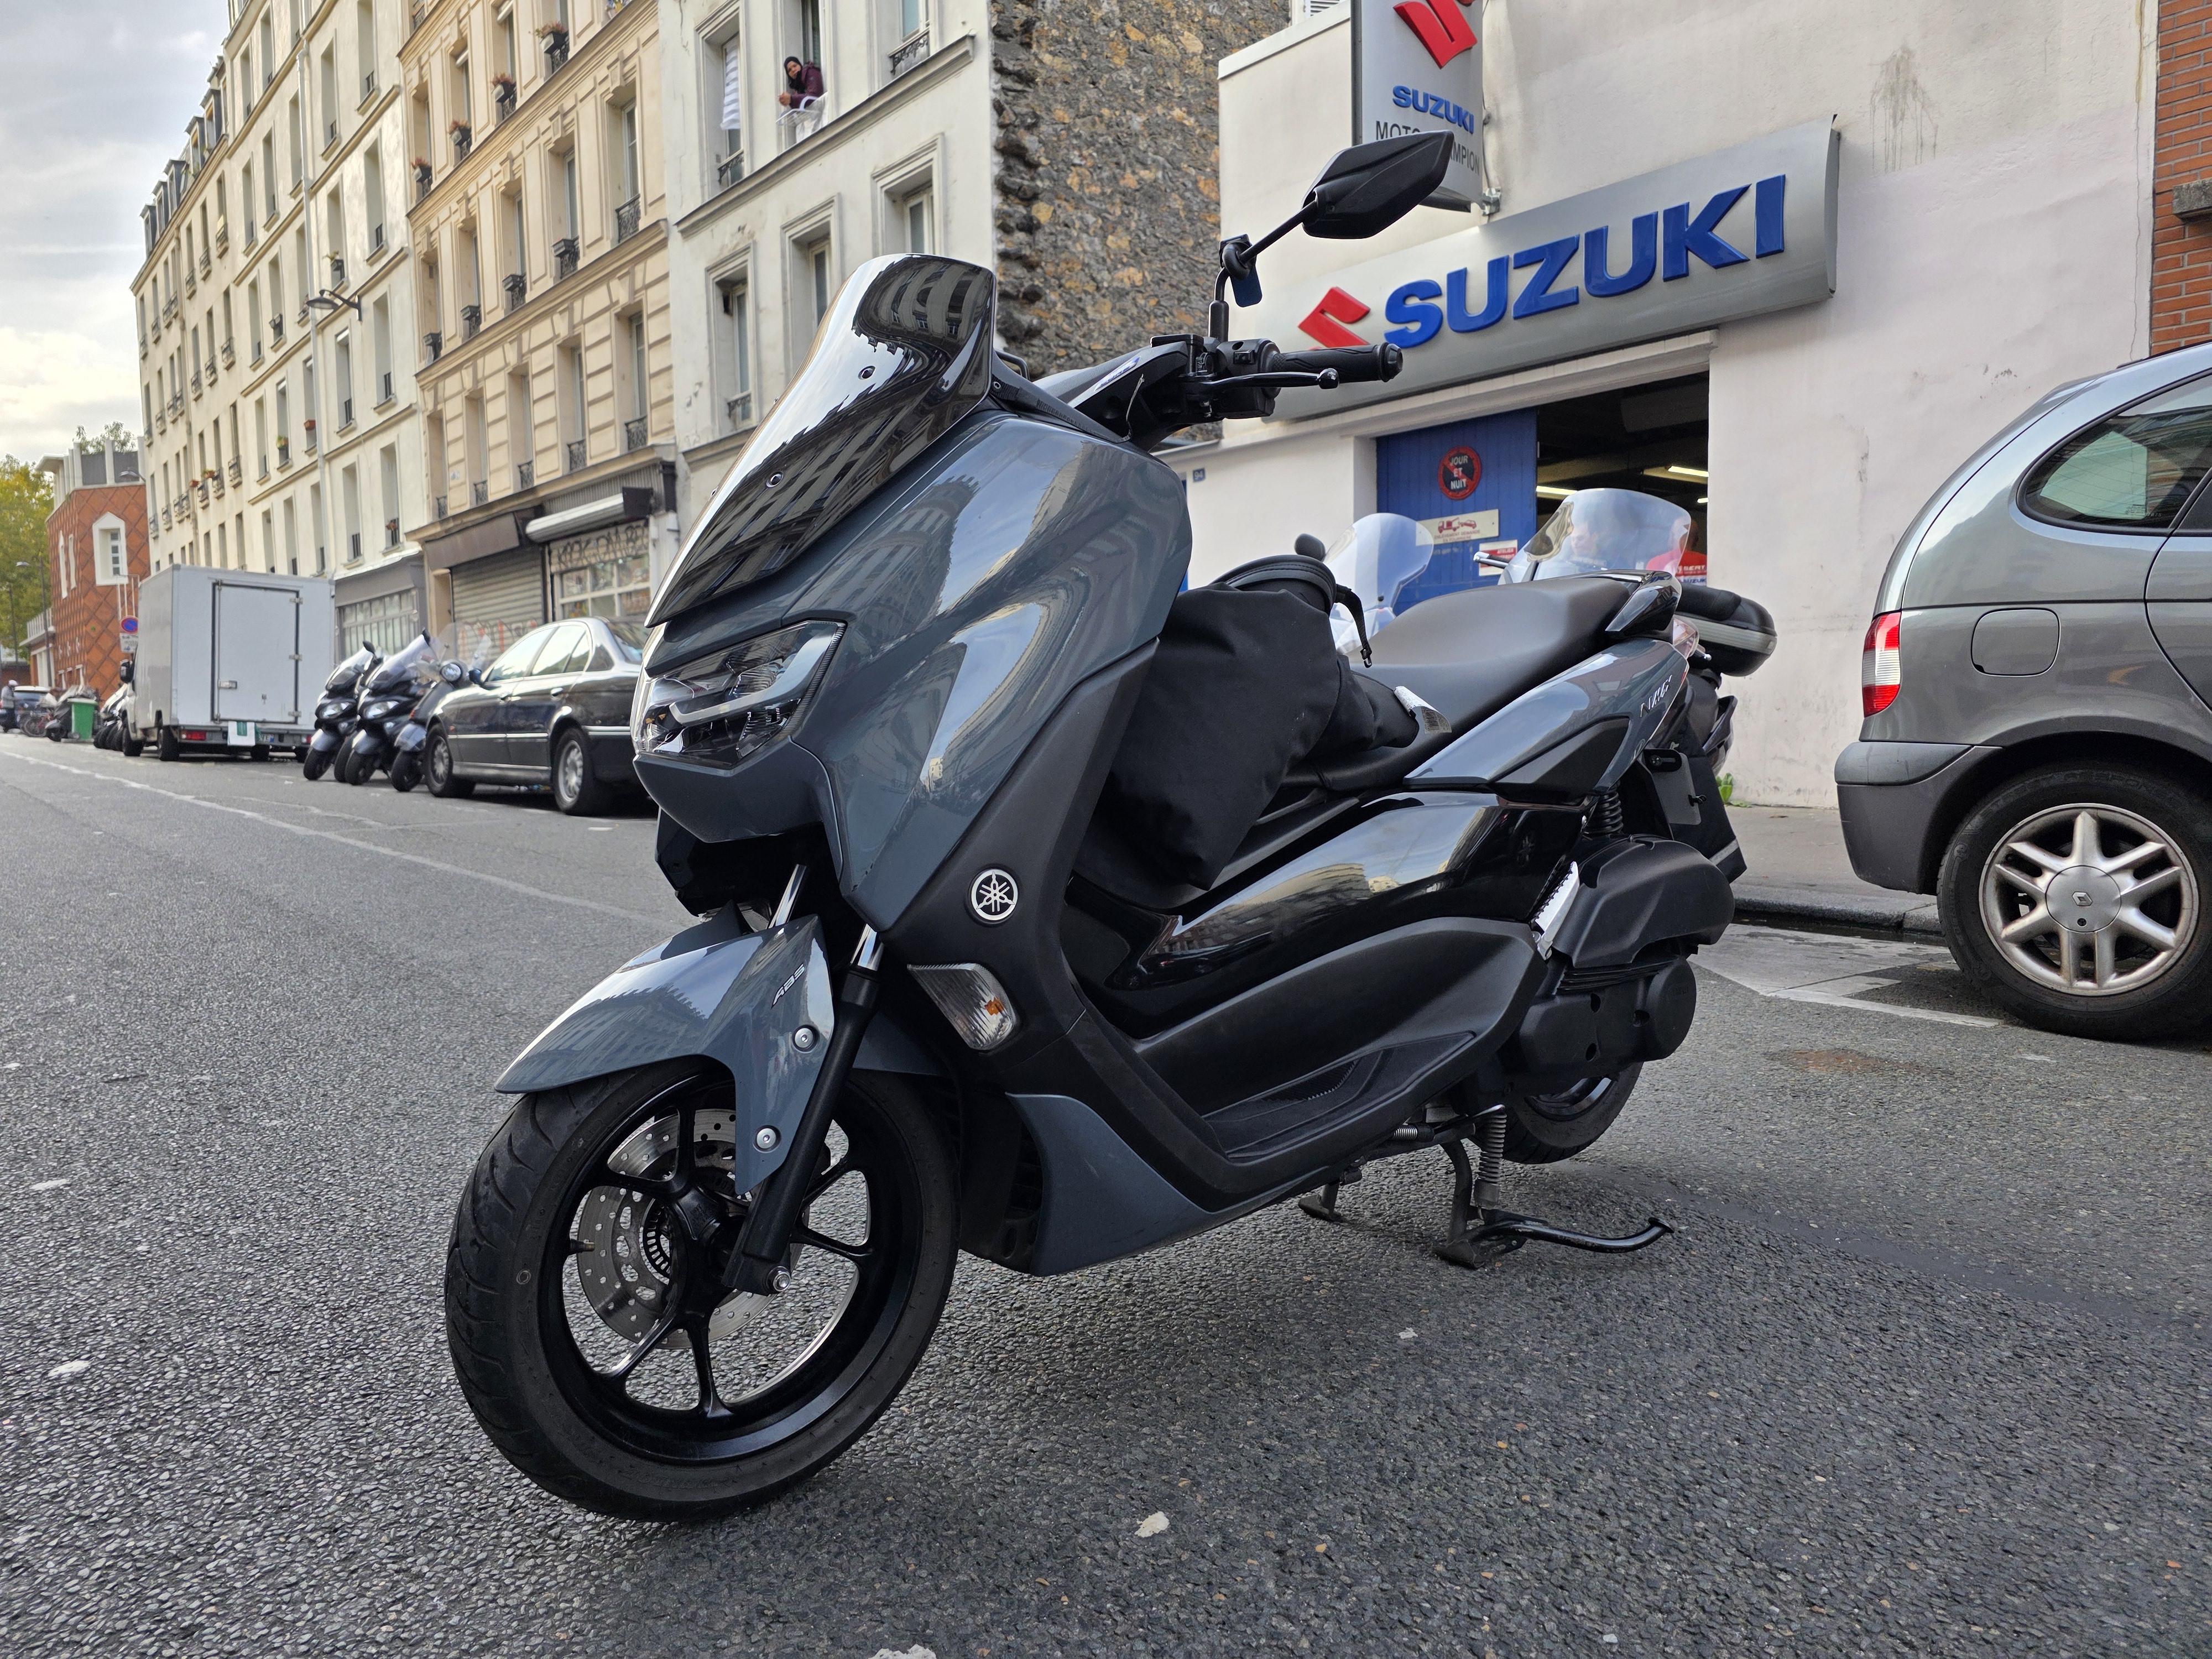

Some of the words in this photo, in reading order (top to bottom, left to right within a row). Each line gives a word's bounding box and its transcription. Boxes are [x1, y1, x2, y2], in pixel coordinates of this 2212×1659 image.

[1392, 85, 1474, 135] SUZUKI
[1450, 142, 1480, 176] MPION
[1384, 174, 1786, 348] SUZUKI
[1449, 455, 1468, 466] JOUR
[1453, 467, 1463, 477] ET
[1194, 471, 1203, 480] 94
[1451, 478, 1467, 490] NUIT
[771, 963, 805, 1008] ABS
